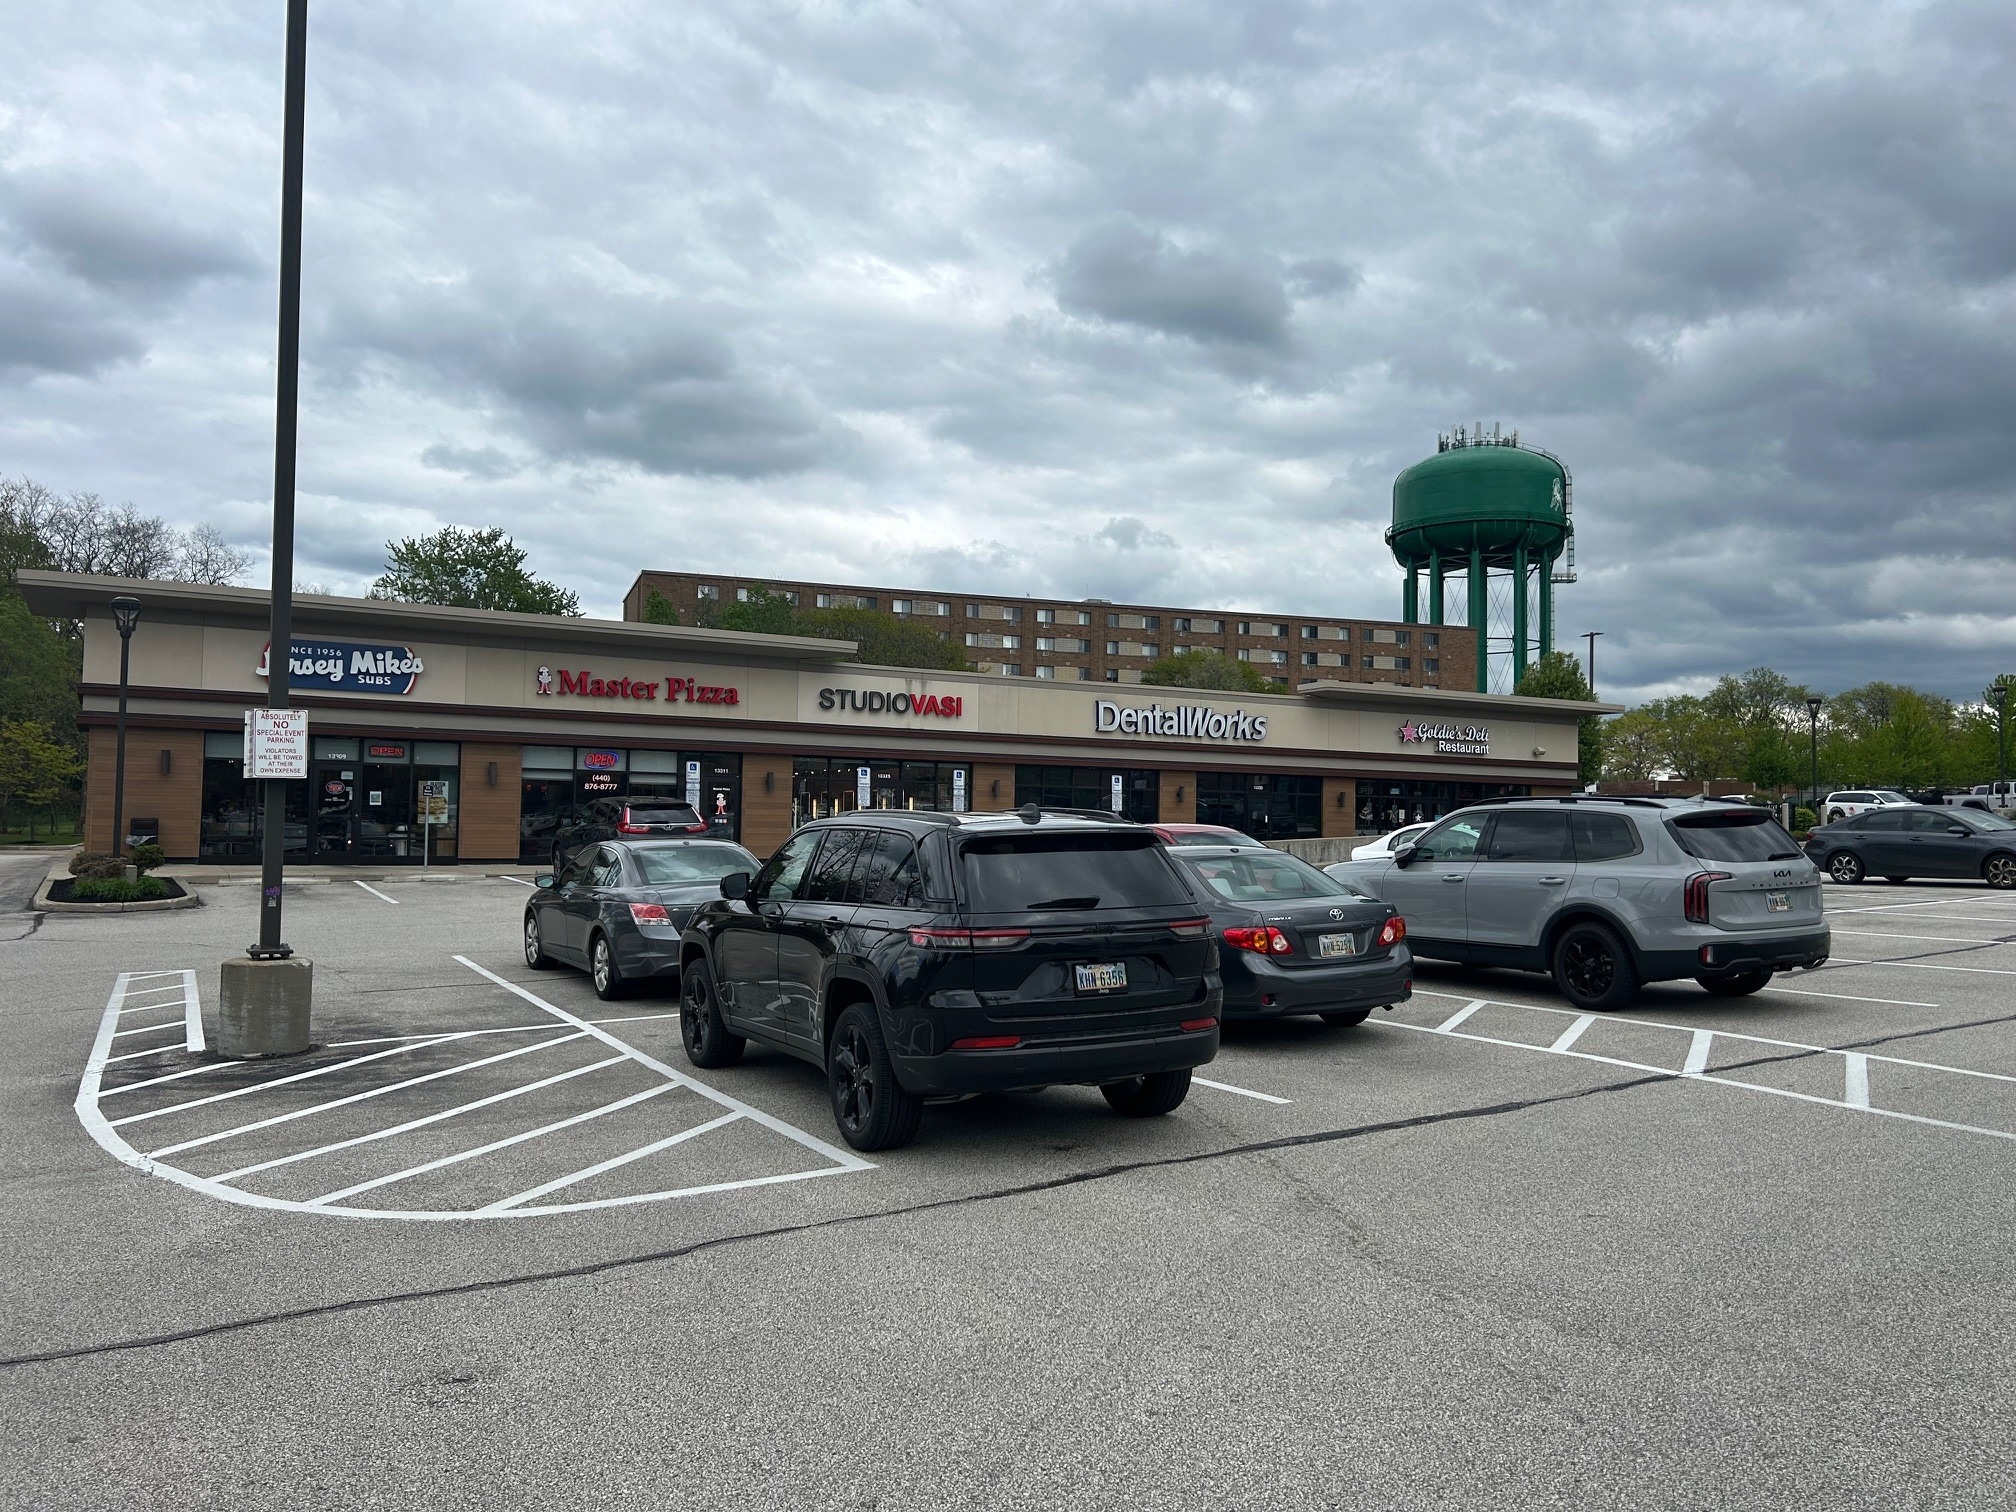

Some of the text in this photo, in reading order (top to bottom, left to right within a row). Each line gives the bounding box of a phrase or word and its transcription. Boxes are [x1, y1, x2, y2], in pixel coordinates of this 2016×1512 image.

[317, 648, 342, 656] 1956
[255, 650, 424, 682] Jrsey Mike's
[357, 675, 391, 685] SUBS
[557, 669, 740, 705] Master Pizza
[273, 720, 289, 729] NO
[1095, 700, 1268, 740] DentalWorks
[1417, 722, 1489, 742] Goldie's Deli
[370, 746, 404, 756] OPEN
[1438, 740, 1489, 755] Restaurant
[585, 752, 617, 767] OPEN
[592, 774, 611, 783] (440)
[584, 783, 618, 791] 876-8777
[1773, 869, 1792, 878] KIA
[1078, 970, 1124, 989] KHN 6356
